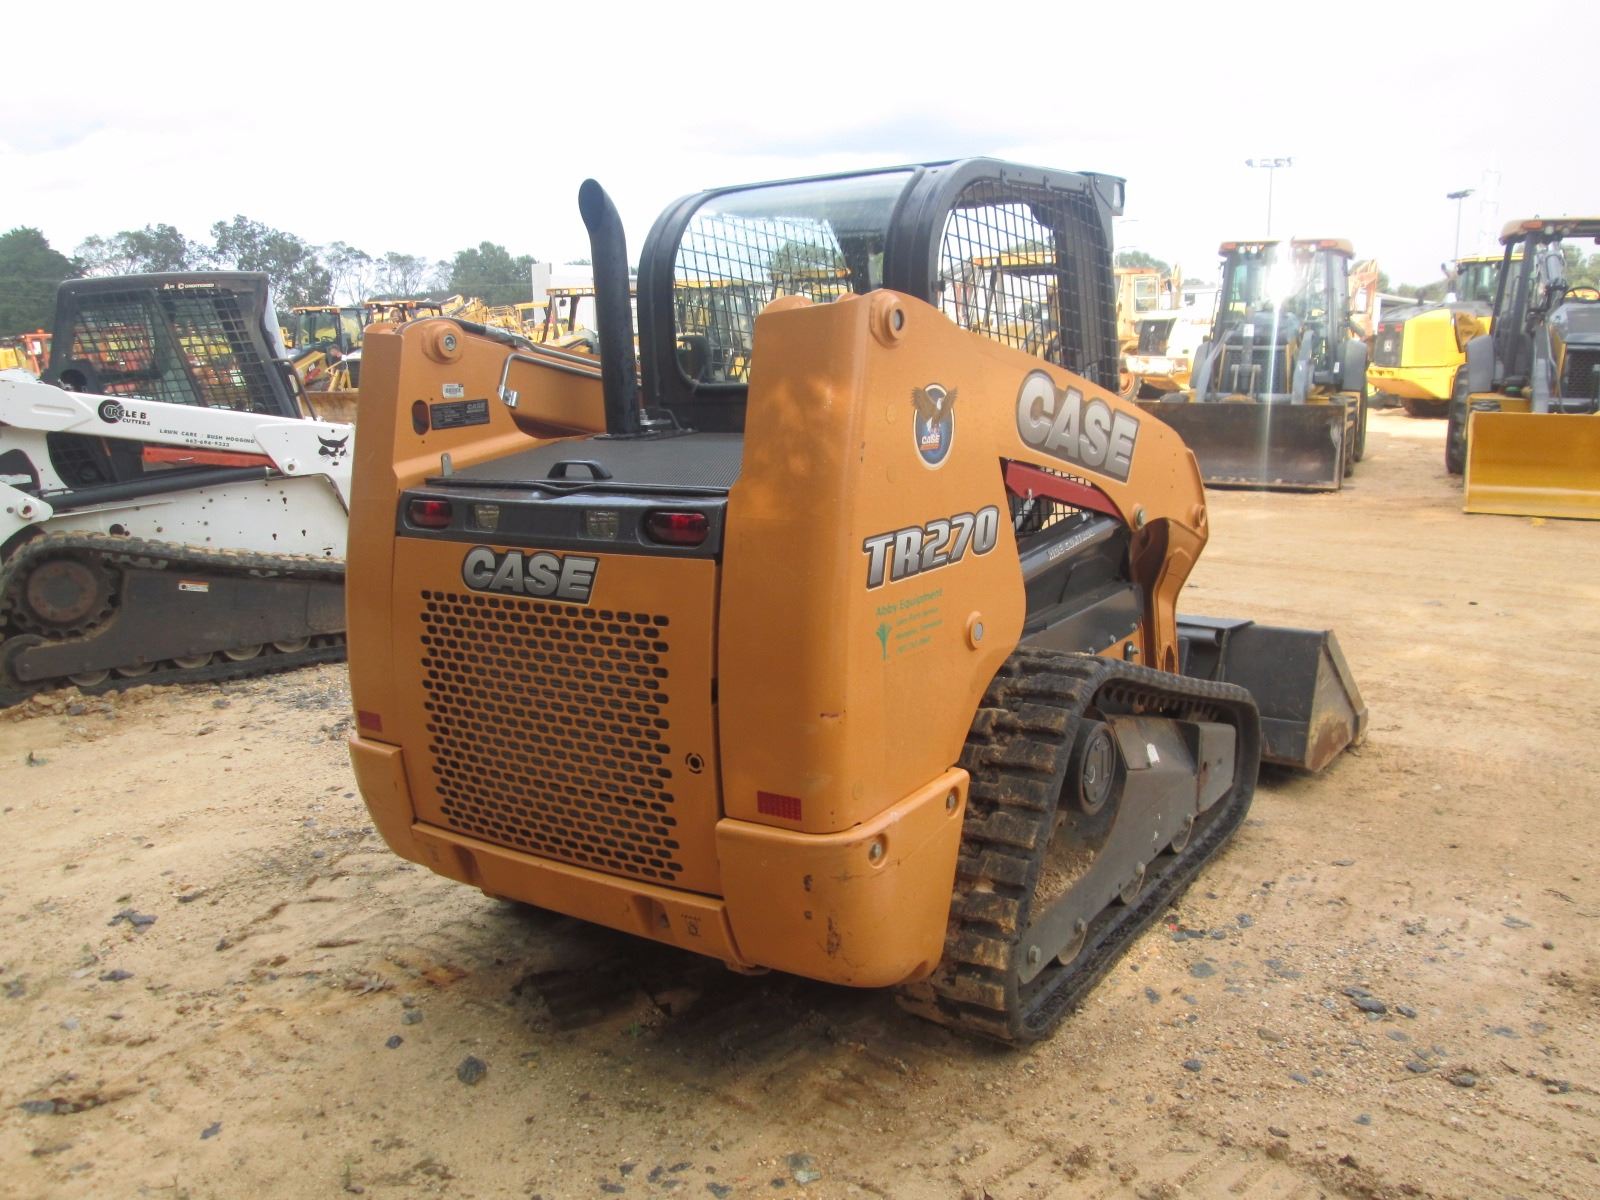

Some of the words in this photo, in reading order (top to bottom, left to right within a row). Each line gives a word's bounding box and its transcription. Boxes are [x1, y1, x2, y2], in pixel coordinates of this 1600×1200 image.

[122, 418, 151, 426] CUTTERS
[140, 411, 147, 420] B
[160, 428, 178, 436] LAWN
[1016, 369, 1139, 483] CASE
[863, 504, 999, 590] TR270
[462, 546, 598, 603] CASE
